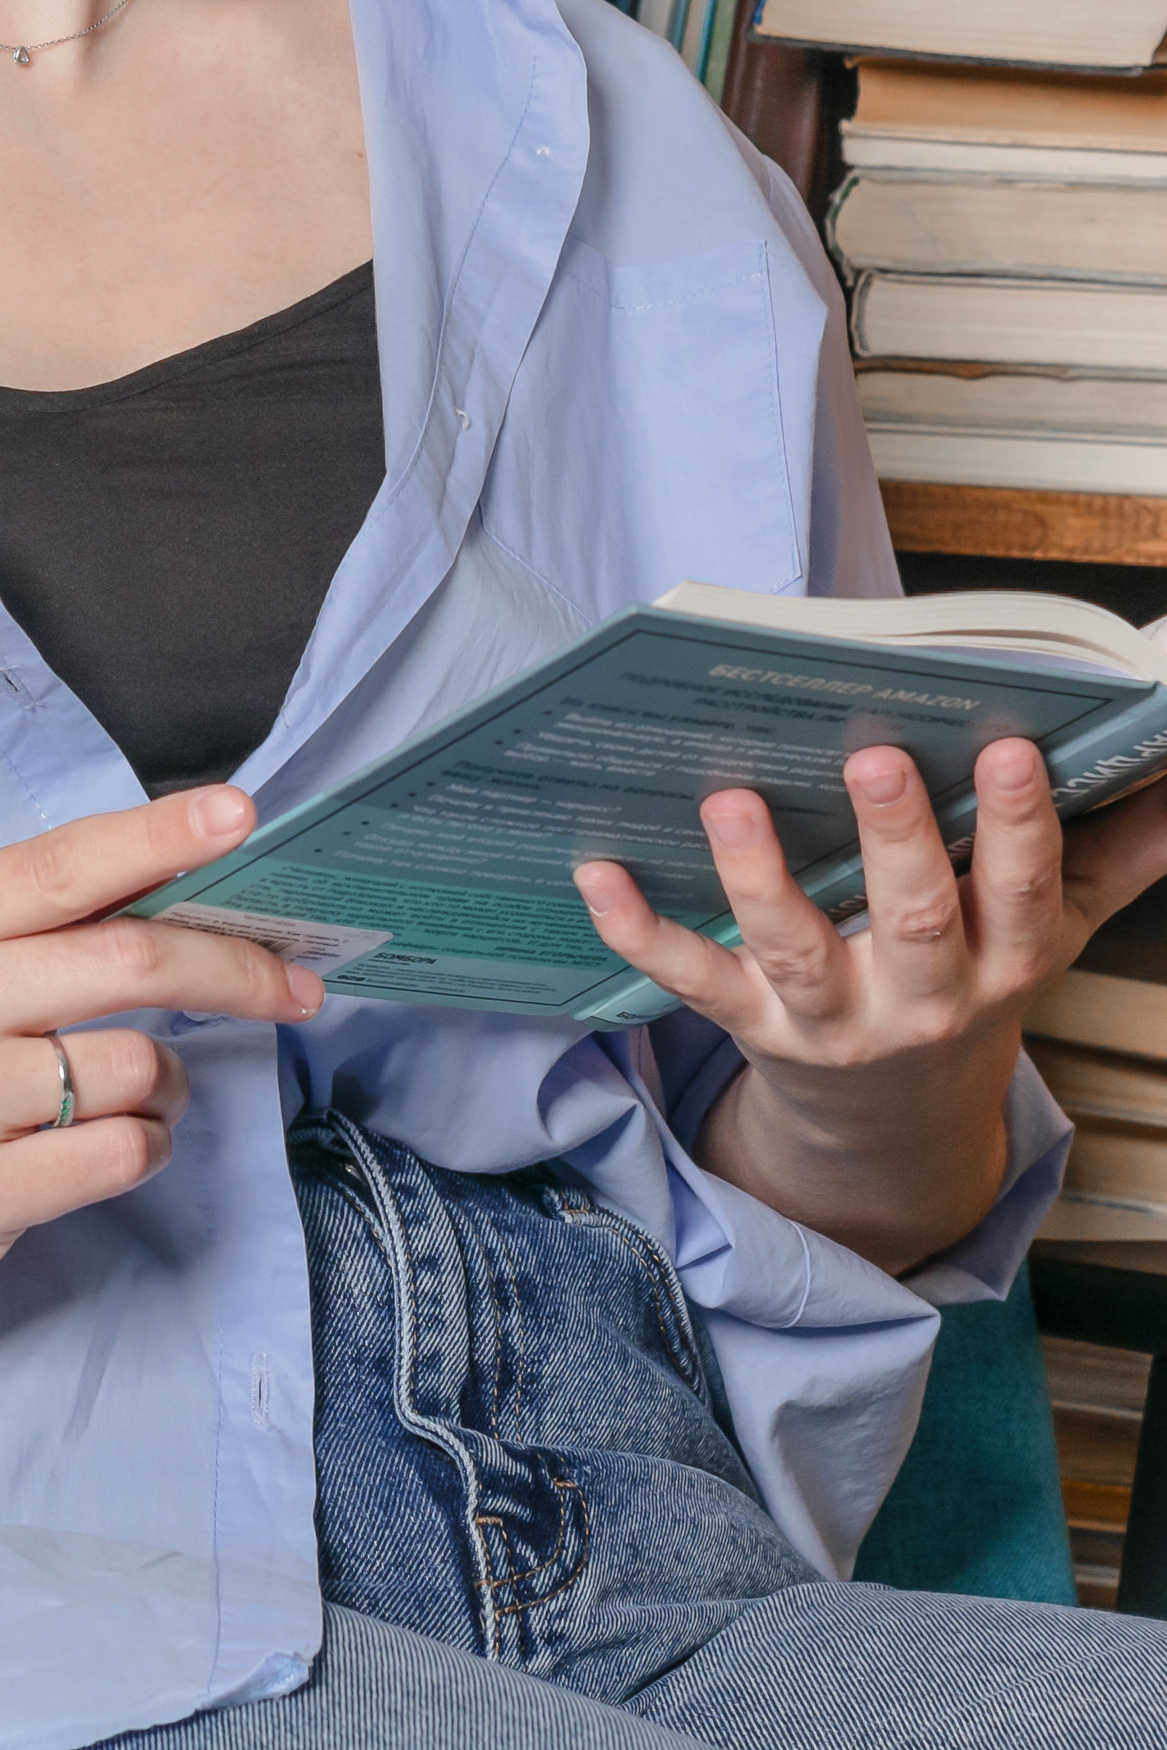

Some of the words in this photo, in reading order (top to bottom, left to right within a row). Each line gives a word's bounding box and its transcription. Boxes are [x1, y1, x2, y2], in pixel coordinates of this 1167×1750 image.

[709, 666, 872, 696] БЕСТСЕЛЛЕР
[874, 689, 978, 710] AMAZON
[496, 946, 535, 956] ИРИНА
[374, 952, 436, 965] БОМБОРА
